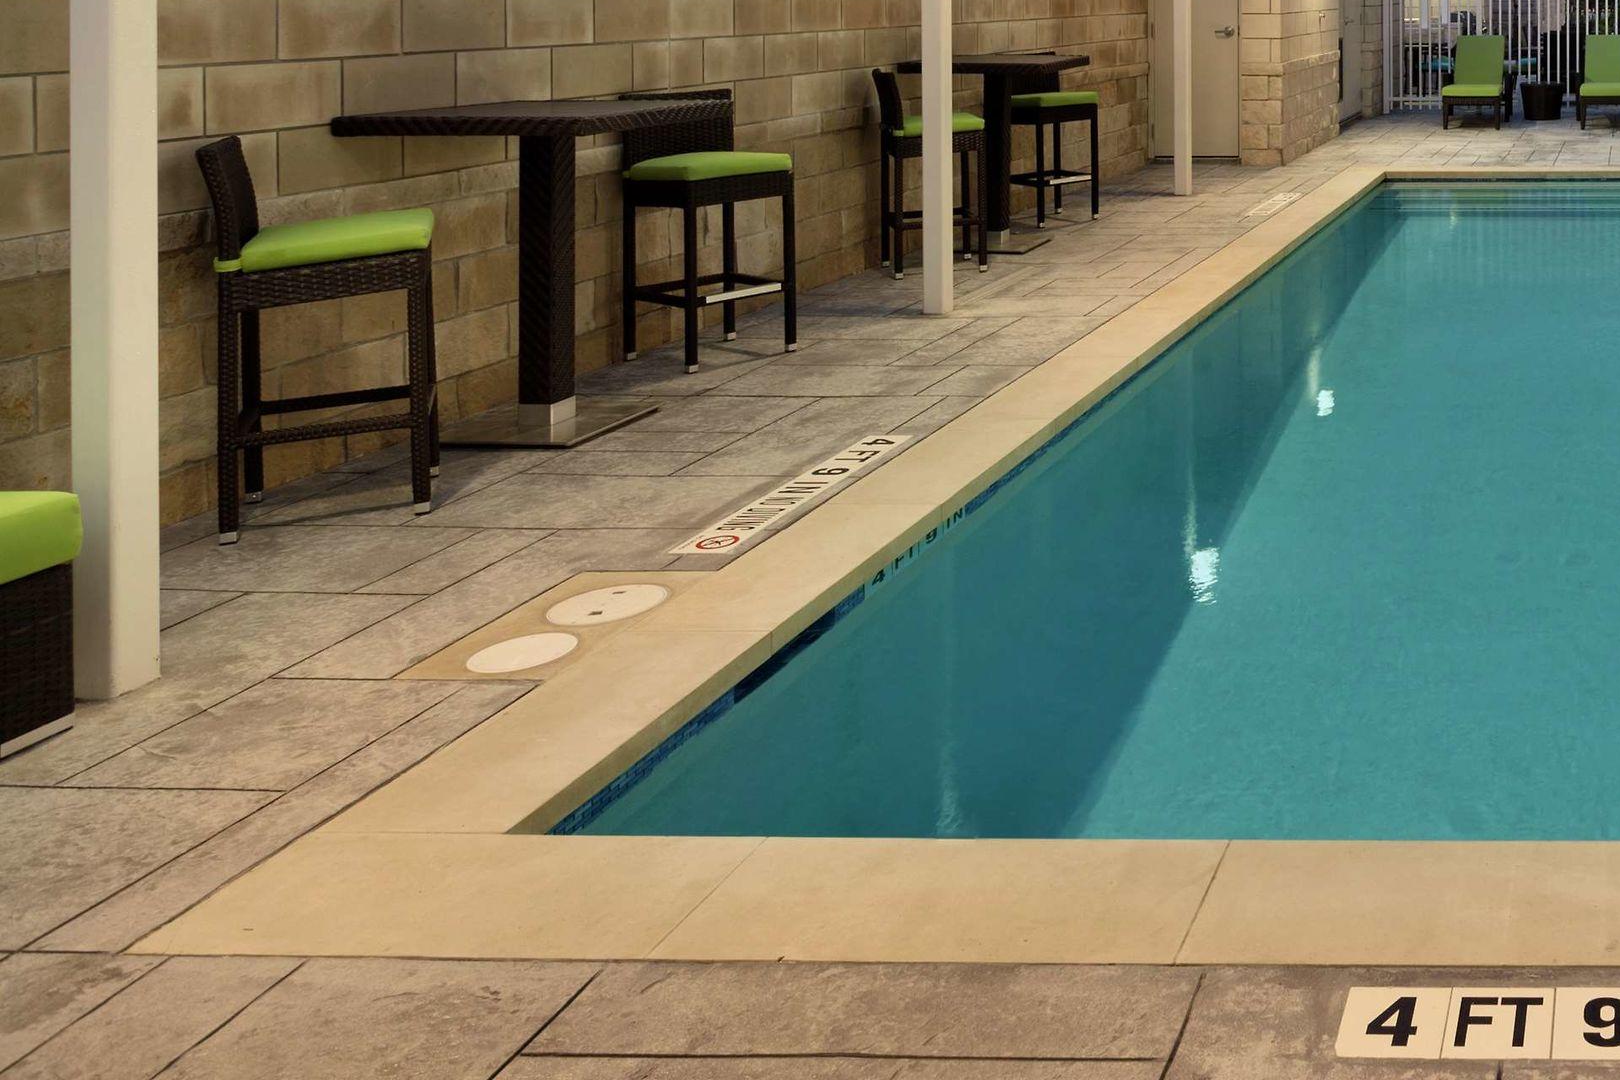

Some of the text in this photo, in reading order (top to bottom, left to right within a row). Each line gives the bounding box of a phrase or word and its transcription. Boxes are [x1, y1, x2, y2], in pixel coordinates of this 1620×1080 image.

[834, 450, 881, 462] FT
[811, 467, 849, 475] 9
[778, 481, 828, 493] IN
[759, 496, 804, 505] NO
[716, 507, 786, 530] DIVING
[1365, 996, 1418, 1046] 4
[1453, 996, 1544, 1047] FT
